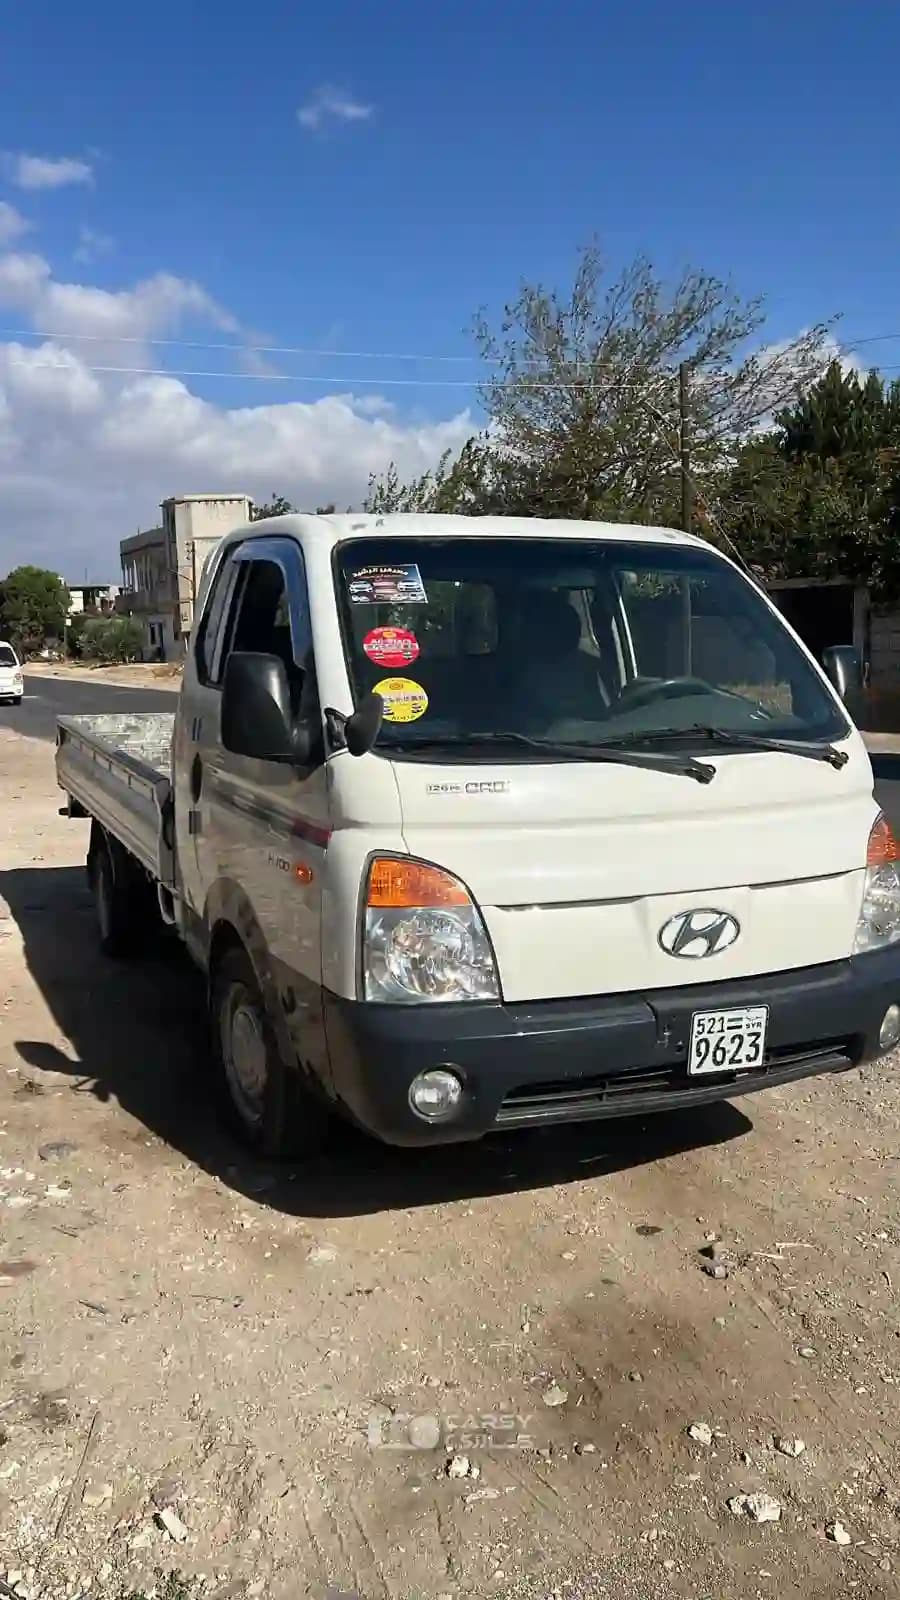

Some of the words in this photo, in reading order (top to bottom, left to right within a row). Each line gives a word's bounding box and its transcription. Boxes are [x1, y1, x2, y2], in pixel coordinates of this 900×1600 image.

[696, 1016, 725, 1035] 521
[745, 1021, 762, 1029] SYR
[695, 1032, 762, 1069] 9623
